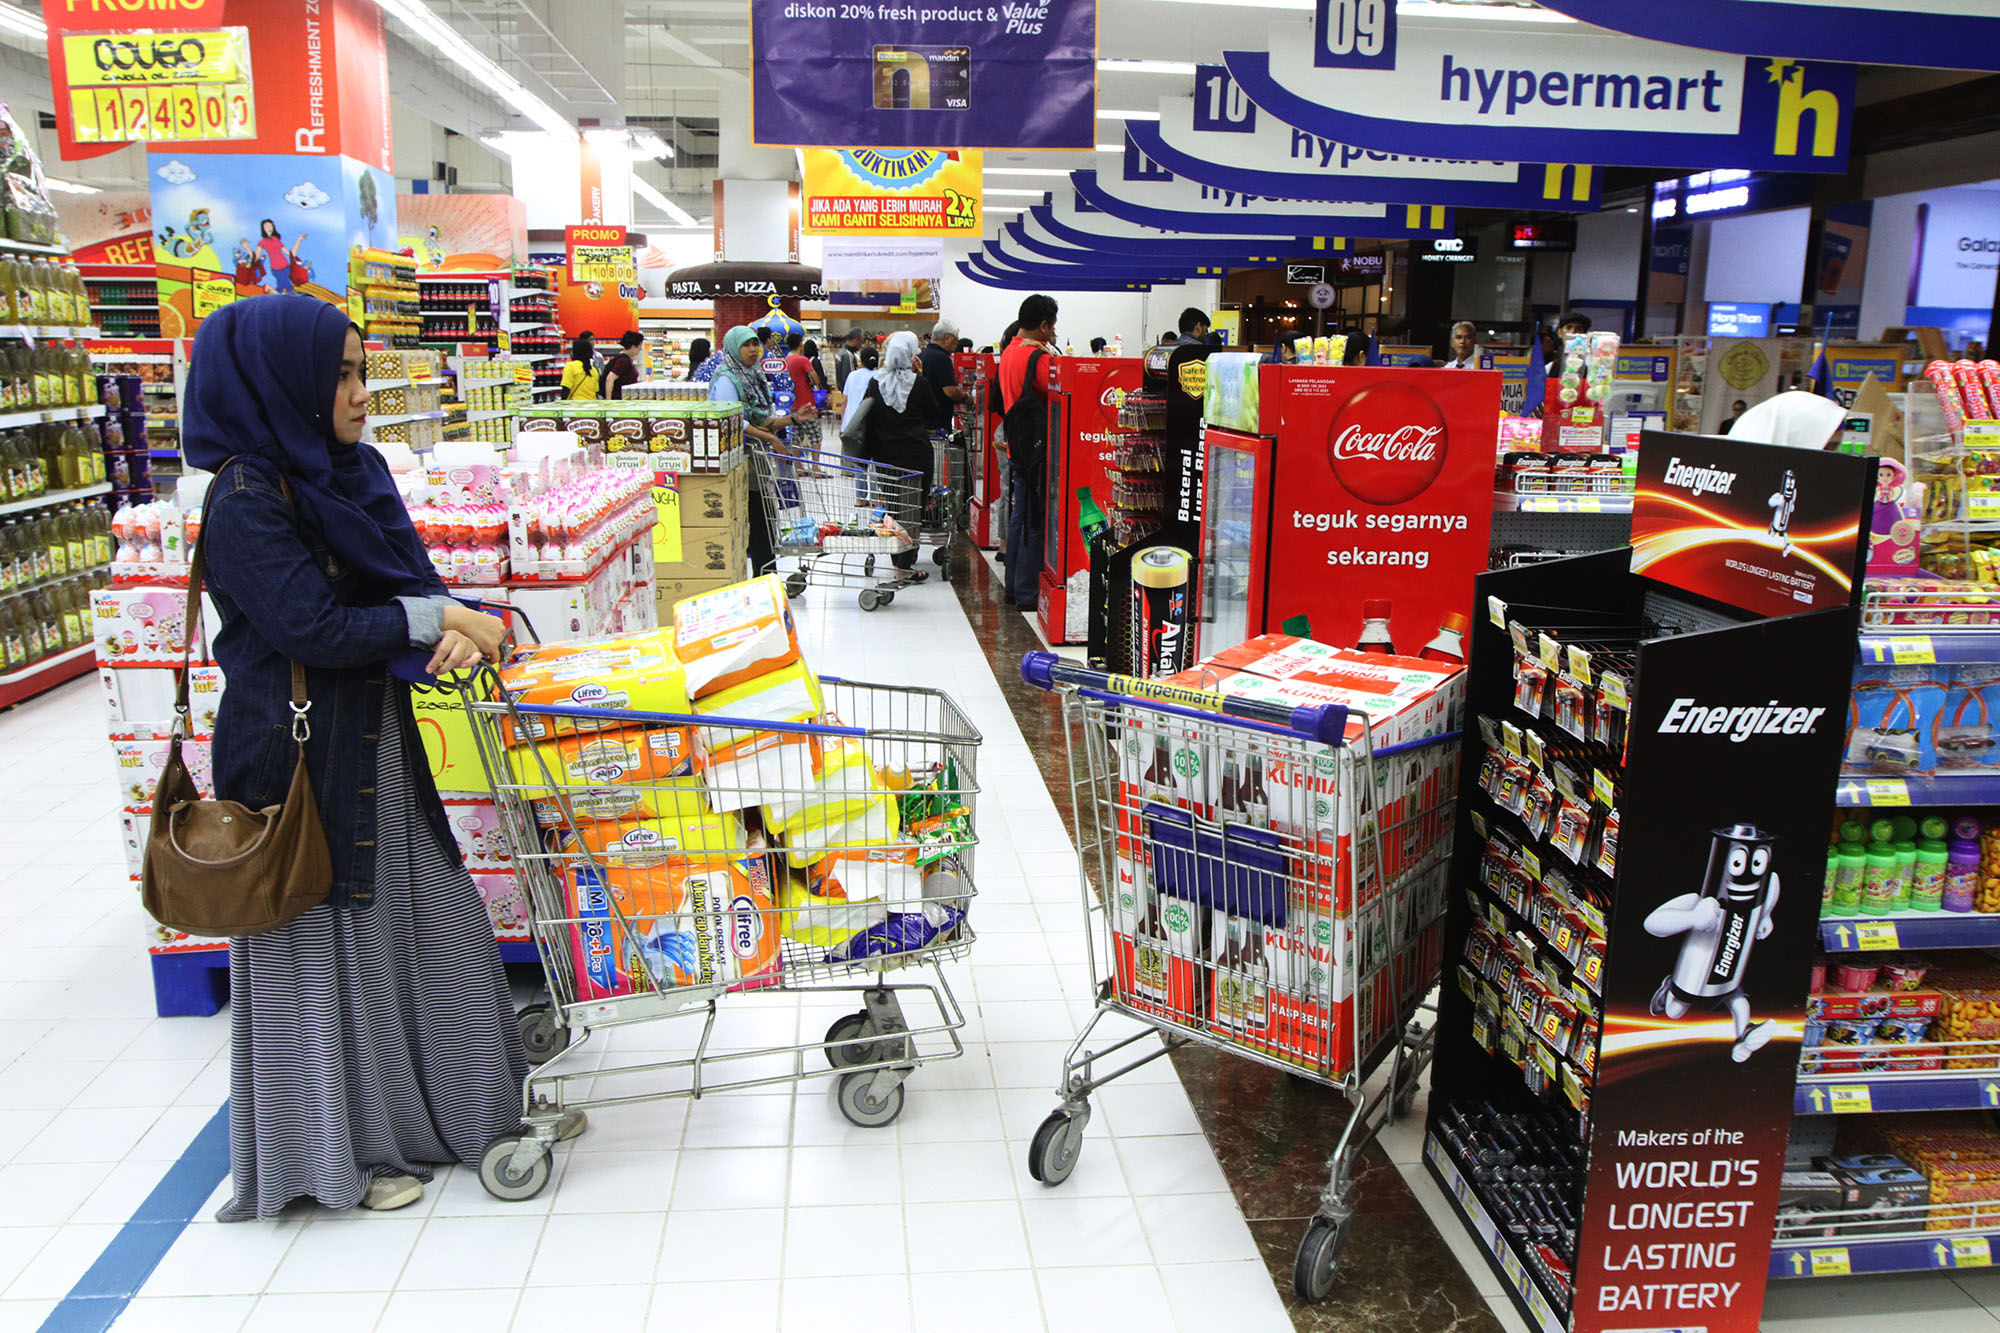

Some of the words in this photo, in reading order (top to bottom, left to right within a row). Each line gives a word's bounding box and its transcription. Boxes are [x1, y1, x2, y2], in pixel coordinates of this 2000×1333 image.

[784, 3, 836, 18] diskon
[840, 5, 875, 19] 20%
[878, 4, 917, 20] fresh
[921, 6, 983, 24] product
[986, 7, 998, 22] &
[1002, 2, 1048, 20] Value
[1005, 19, 1043, 34] Plus
[1327, 0, 1386, 56] 09
[295, 20, 325, 152] REFRESHMENT
[1441, 55, 1724, 115] hypermart
[946, 98, 967, 108] VISA
[1206, 76, 1249, 123] 10
[105, 95, 248, 130] 124300
[853, 150, 934, 178] BUKTIKAN!
[810, 199, 831, 213] JIKA
[832, 199, 851, 213] ADA
[854, 199, 879, 213] YANG
[881, 200, 907, 213] LEBIH
[909, 200, 943, 213] MURAH
[812, 213, 841, 227] KAMI
[843, 213, 876, 227] GANTI
[879, 213, 944, 227] SELISIHNYA
[947, 216, 975, 228] LIPAT
[573, 229, 620, 240] PROMO
[714, 227, 724, 263] BAKERY
[789, 228, 799, 263] BAKERY
[1958, 236, 2000, 252] Gala
[105, 236, 153, 265] REF
[1353, 256, 1383, 266] NOBU
[1421, 254, 1444, 262] MONEY
[672, 281, 702, 294] PASTA
[735, 281, 777, 293] PIZZA
[1711, 312, 1736, 323] More
[1737, 313, 1762, 324] Than
[1079, 431, 1108, 444] tegu
[1333, 424, 1443, 462] Coca-Cola
[1177, 449, 1193, 523] Baterai
[1664, 456, 1737, 497] Energizer
[1292, 510, 1358, 533] teguk
[1365, 512, 1468, 533] segarnya
[1327, 546, 1429, 569] sekarang
[1317, 665, 1389, 681] KURNIA
[577, 687, 603, 698] Lifree
[1134, 680, 1220, 708] hypermart
[1277, 687, 1353, 705] KURNIA
[1658, 698, 1826, 742] Energizer
[1267, 767, 1342, 797] KURNIA
[590, 891, 603, 905] M
[1265, 931, 1338, 967] KURNIA
[1714, 913, 1745, 978] Energizer
[1588, 961, 1597, 974] 6
[1271, 1002, 1337, 1033] RASPBERRY
[1547, 1018, 1555, 1031] 6
[1617, 1130, 1688, 1147] Makers
[1692, 1128, 1712, 1145] of
[1714, 1128, 1744, 1145] the
[1616, 1160, 1760, 1189] WORLD'S
[1608, 1201, 1754, 1230] LONGEST
[1603, 1242, 1737, 1271] LASTING
[1598, 1282, 1741, 1312] BATTERY
